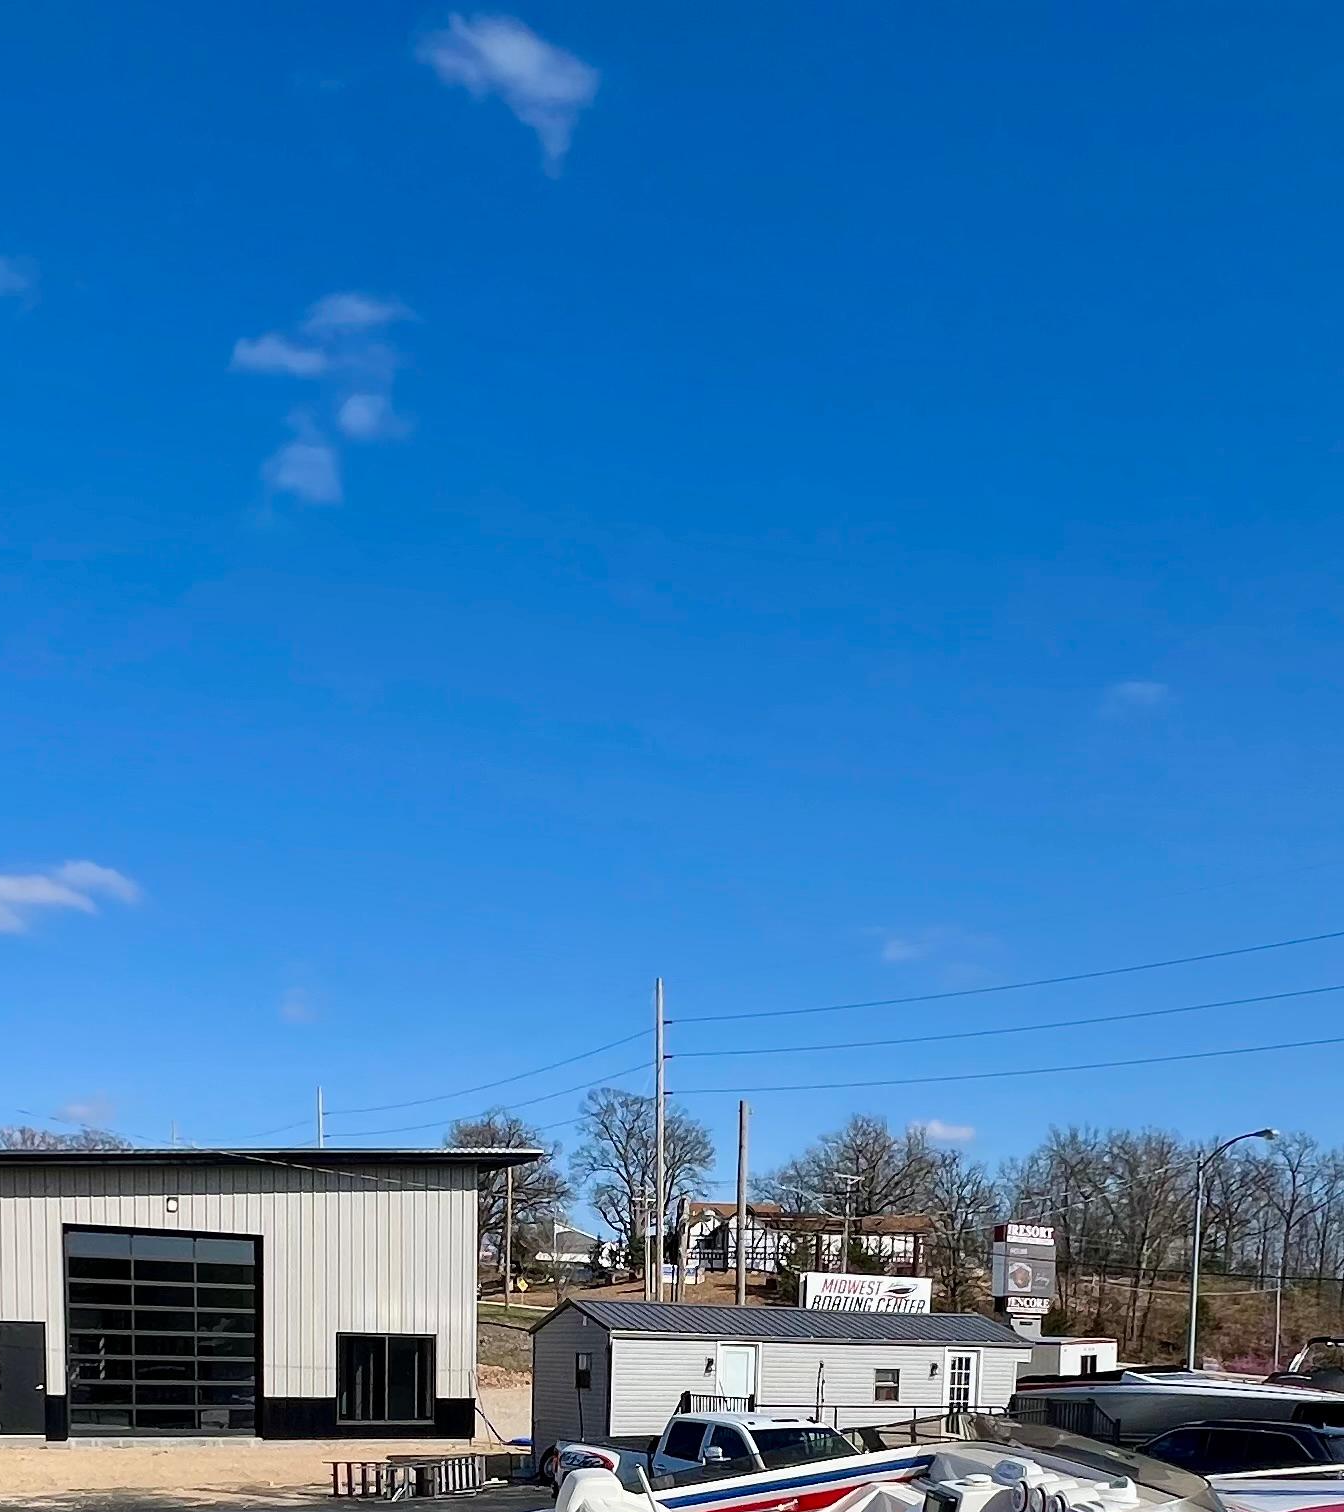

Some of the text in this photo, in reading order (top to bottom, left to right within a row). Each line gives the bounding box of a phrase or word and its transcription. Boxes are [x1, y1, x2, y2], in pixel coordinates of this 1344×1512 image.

[821, 1278, 883, 1296] MIDWEST
[811, 1294, 926, 1314] BOATING CENTER
